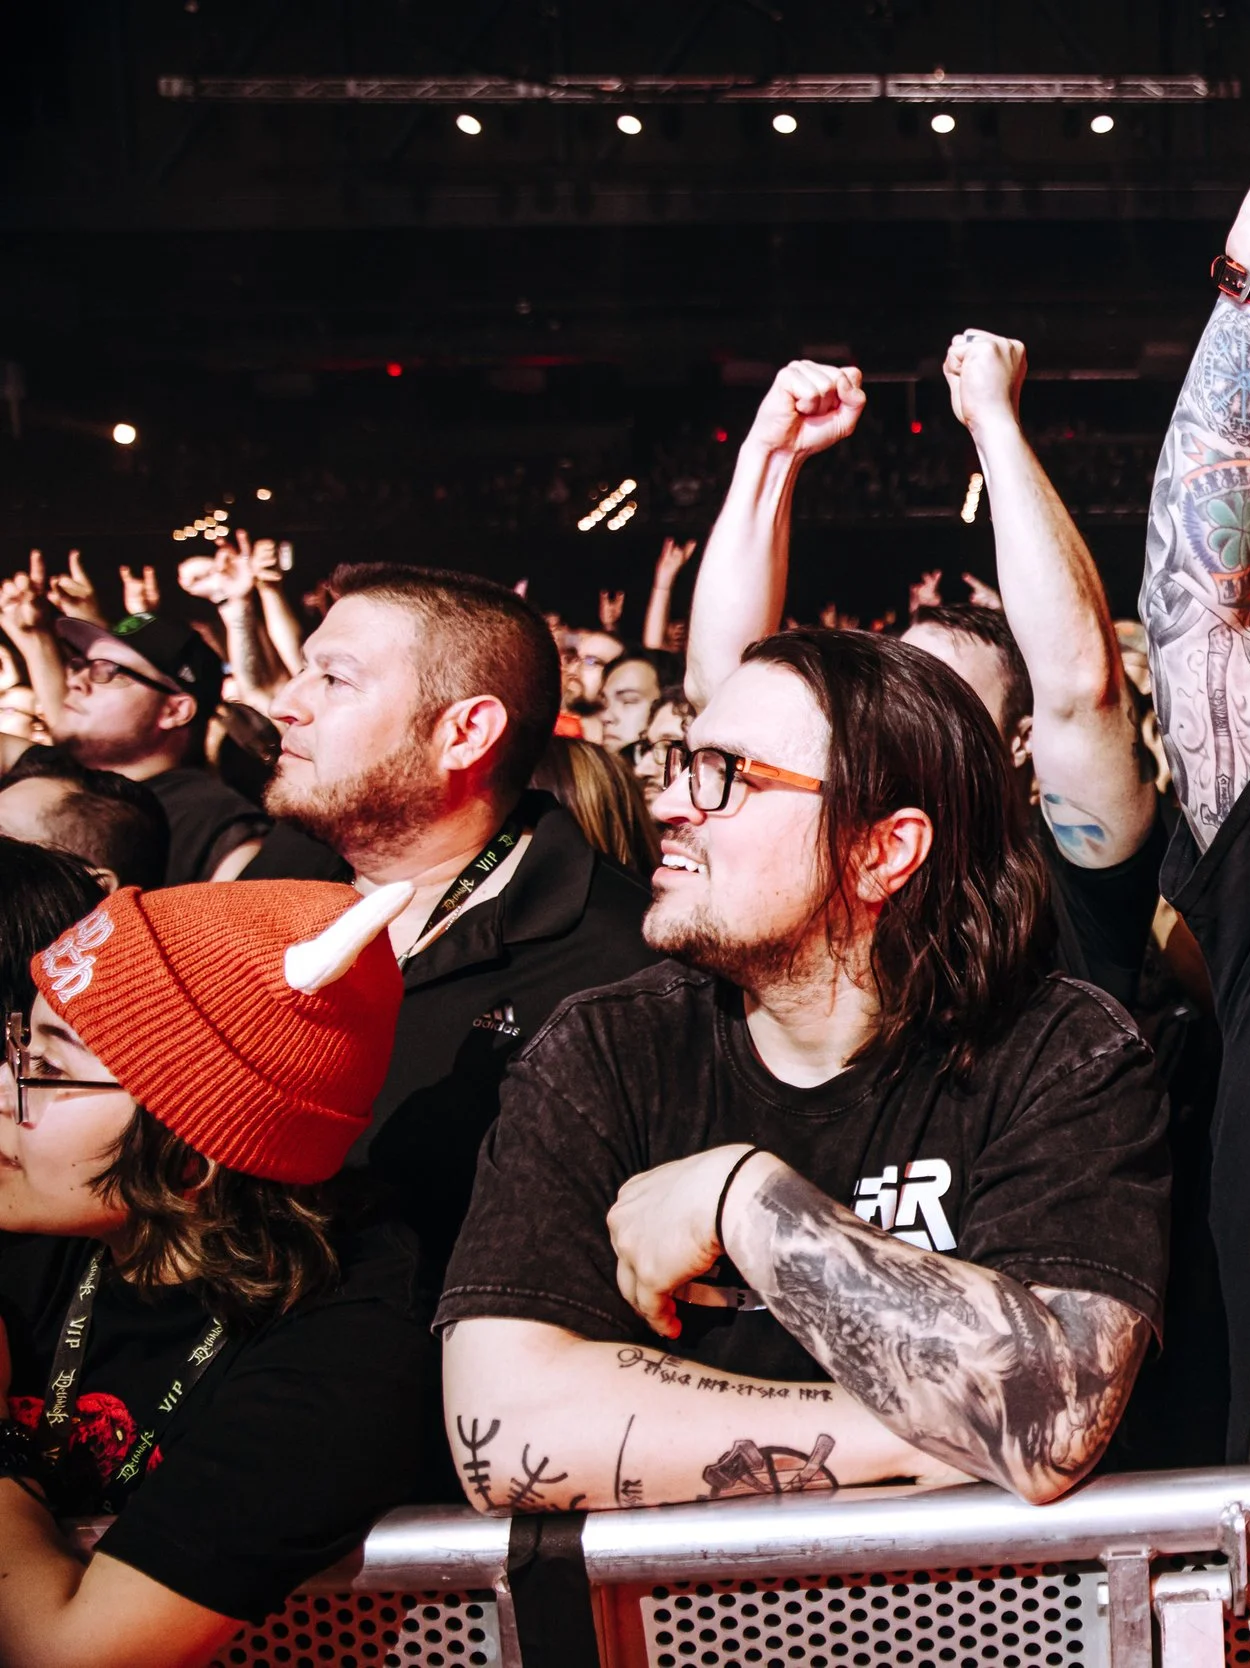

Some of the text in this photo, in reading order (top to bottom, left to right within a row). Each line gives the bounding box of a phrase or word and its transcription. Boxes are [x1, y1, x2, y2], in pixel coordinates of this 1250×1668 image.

[475, 850, 498, 872] VIP
[472, 1017, 521, 1037] adidas
[65, 1315, 88, 1349] VIP
[158, 1380, 184, 1413] VIP
